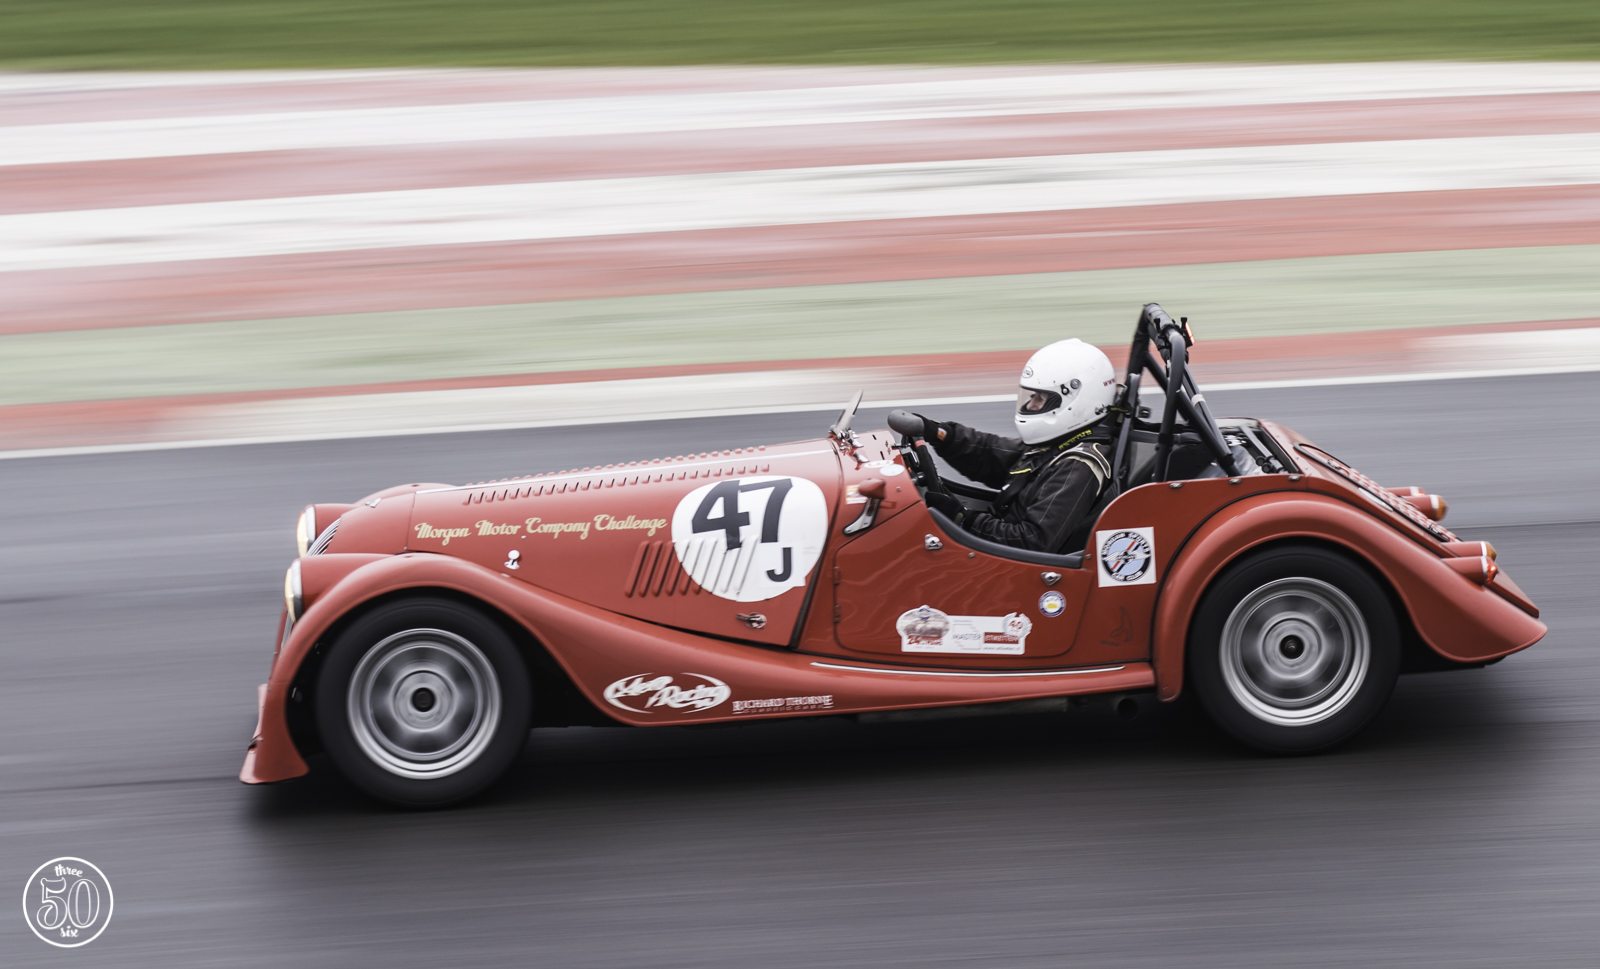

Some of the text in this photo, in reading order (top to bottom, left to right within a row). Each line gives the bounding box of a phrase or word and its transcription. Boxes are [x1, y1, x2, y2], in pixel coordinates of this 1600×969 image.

[414, 514, 668, 546] Morgan Motor Company Challenge
[691, 478, 793, 551] 47
[766, 547, 793, 582] J
